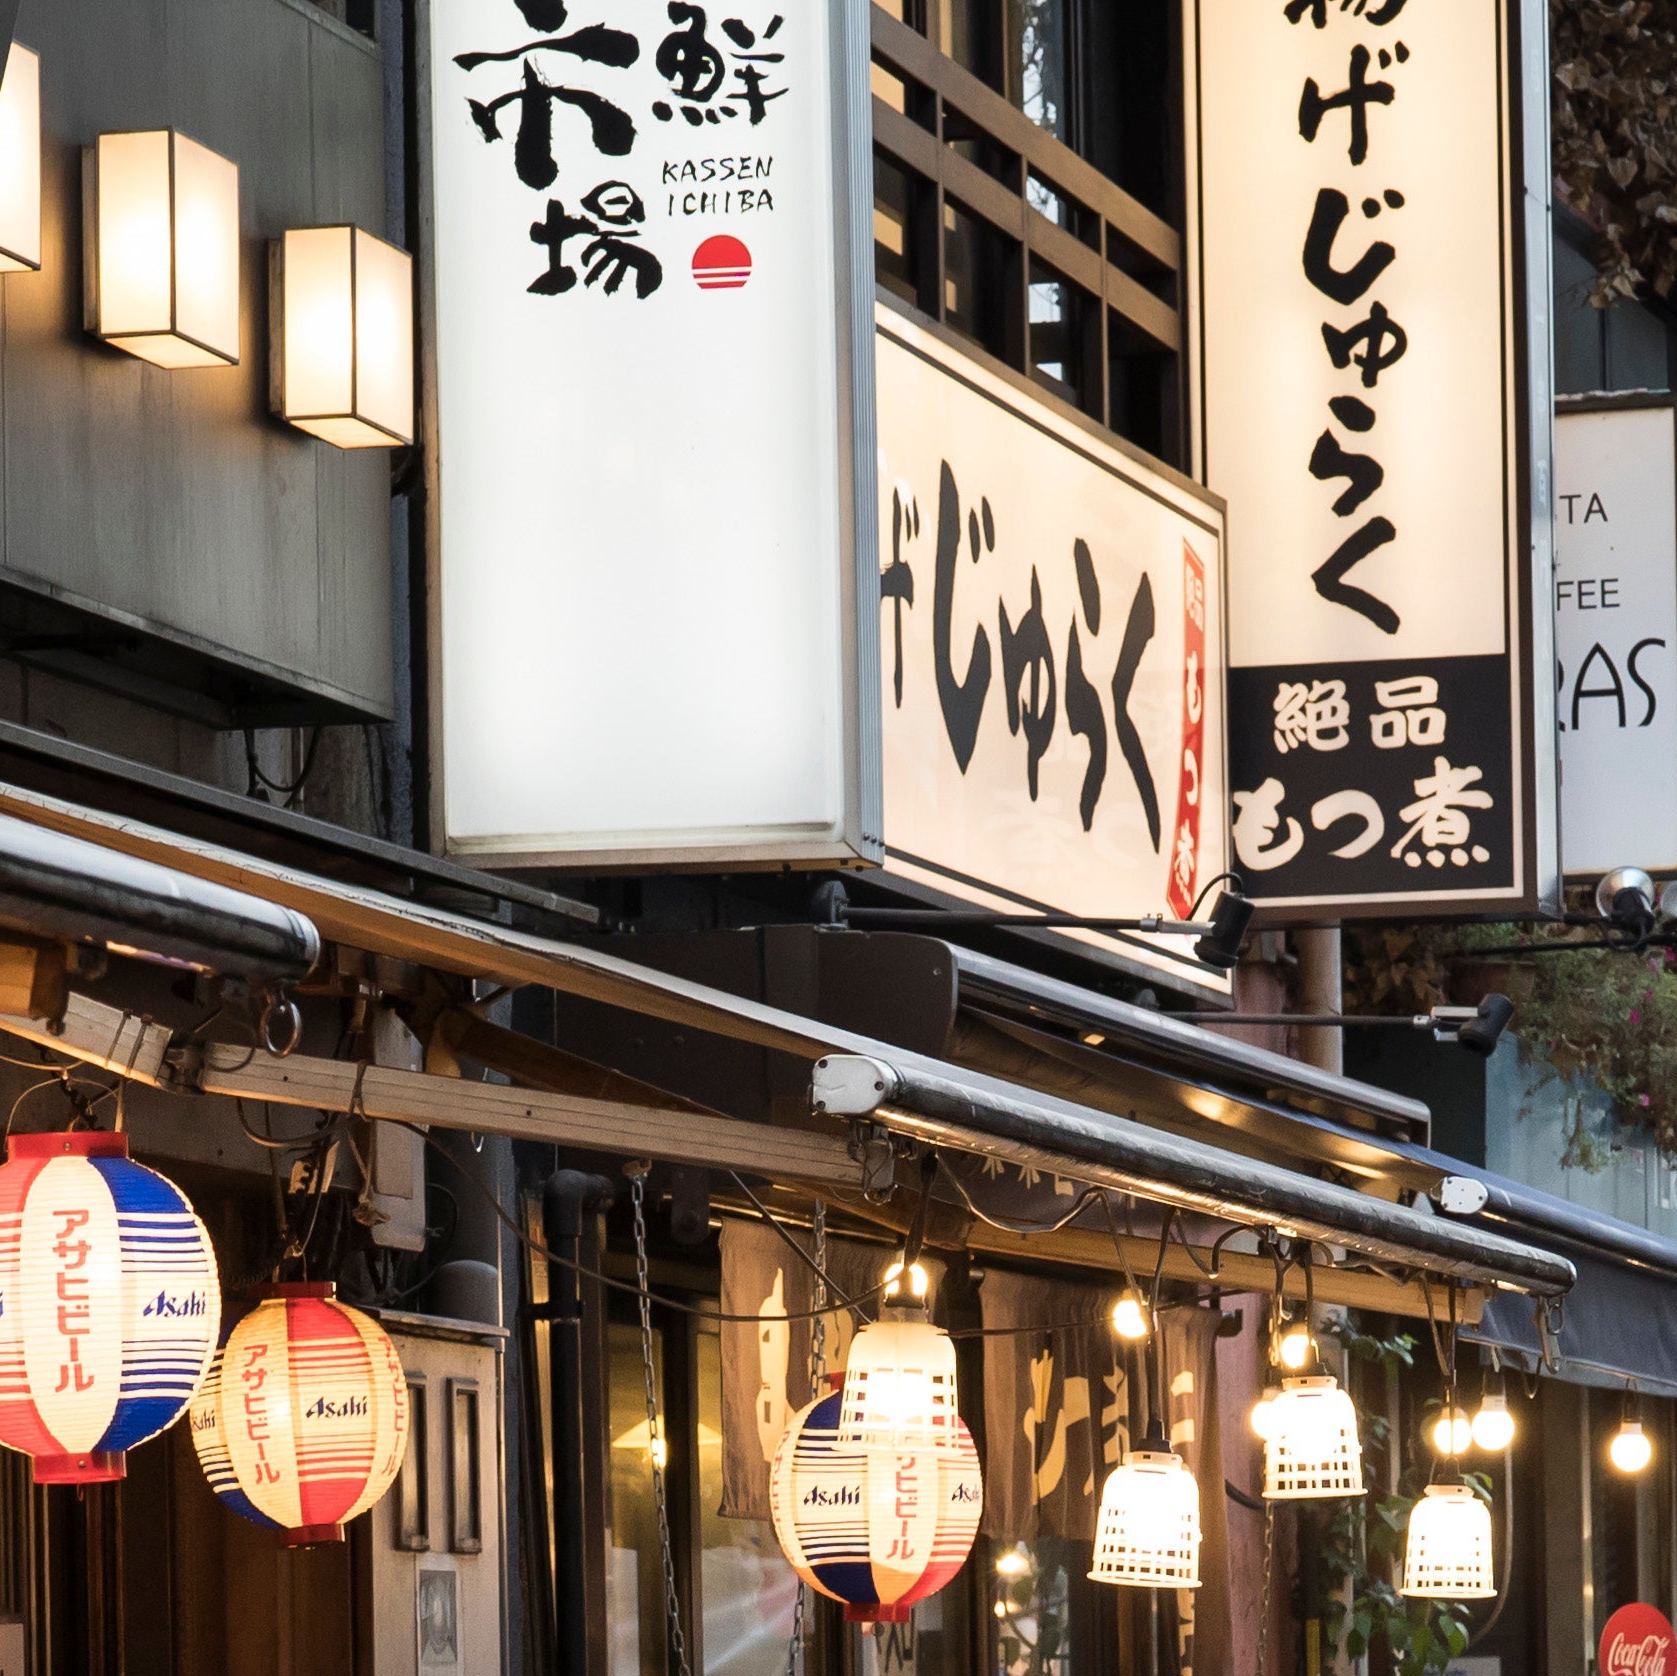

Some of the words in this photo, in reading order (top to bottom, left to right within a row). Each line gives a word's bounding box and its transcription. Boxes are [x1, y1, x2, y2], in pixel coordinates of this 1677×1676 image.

[661, 156, 775, 184] KASSEN
[667, 189, 775, 217] ICHIBA
[1290, 0, 1409, 634] げじゅらく
[1559, 494, 1608, 523] TA
[1556, 579, 1620, 610] FEE
[1556, 637, 1666, 731] AS
[1273, 674, 1449, 756] 絶品
[1232, 757, 1495, 868] もつ煮
[52, 1210, 95, 1393] アサヒビール
[142, 1290, 207, 1319] Asahi
[235, 1344, 282, 1486] アサヒビール
[306, 1396, 369, 1419] Asahi
[803, 1485, 861, 1506] Asahi
